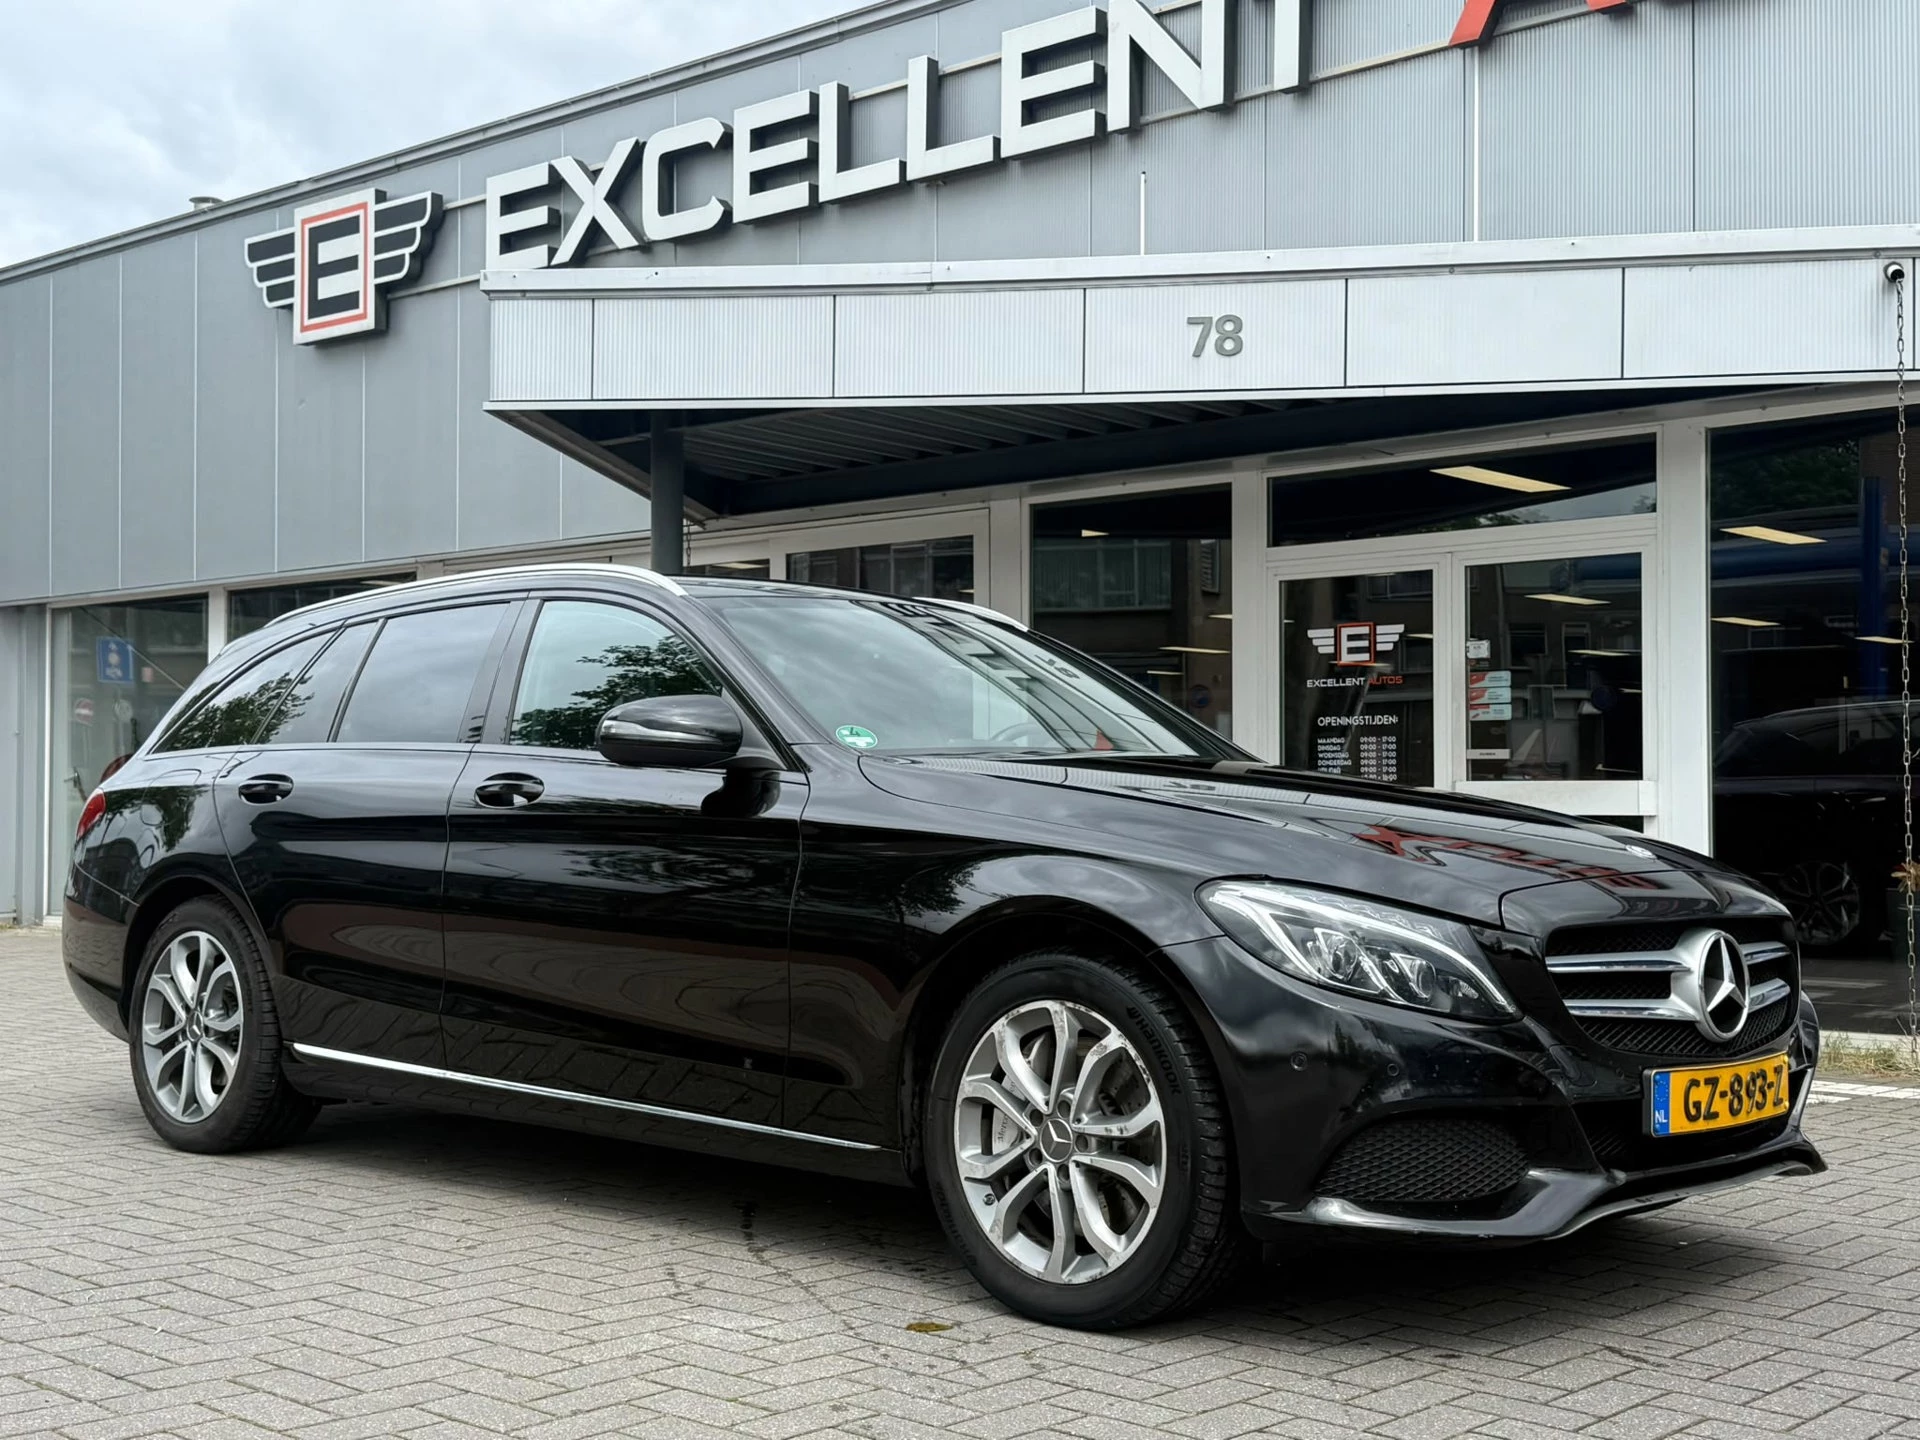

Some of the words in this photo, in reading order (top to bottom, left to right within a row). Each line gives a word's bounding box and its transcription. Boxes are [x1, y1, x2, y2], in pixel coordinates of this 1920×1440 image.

[1187, 314, 1243, 357] 78
[1306, 677, 1366, 688] EXCELLENT
[1368, 675, 1403, 686] AUTOS
[1683, 1064, 1784, 1123] GZ-893-Z
[1655, 1110, 1668, 1123] NL
